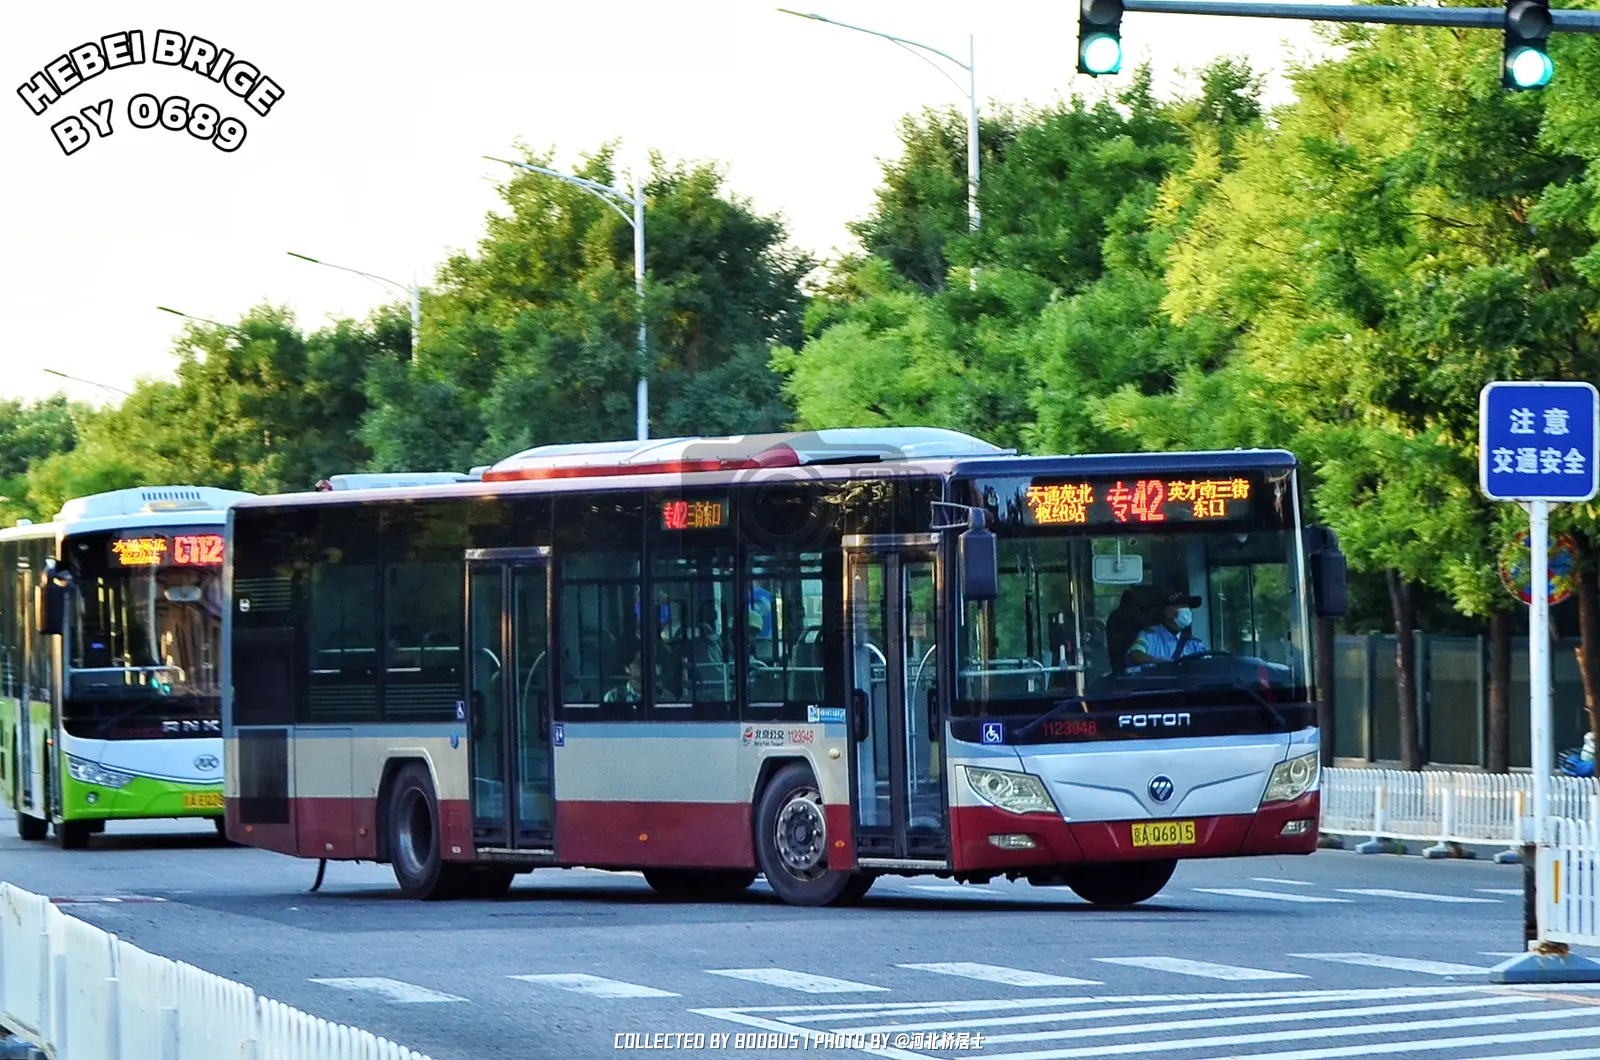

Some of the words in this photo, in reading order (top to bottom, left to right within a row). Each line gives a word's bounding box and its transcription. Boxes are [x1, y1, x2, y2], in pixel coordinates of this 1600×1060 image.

[1509, 407, 1570, 435] 注意
[1492, 447, 1586, 474] 交通安全
[1026, 483, 1094, 506] 天通苑北
[1106, 479, 1164, 522] 专42
[1167, 478, 1250, 501] 英才南三街
[1035, 502, 1086, 524] 枢纽站
[1193, 496, 1225, 518] 东口
[1043, 721, 1097, 736] 1123948
[1118, 713, 1191, 727] FOTON
